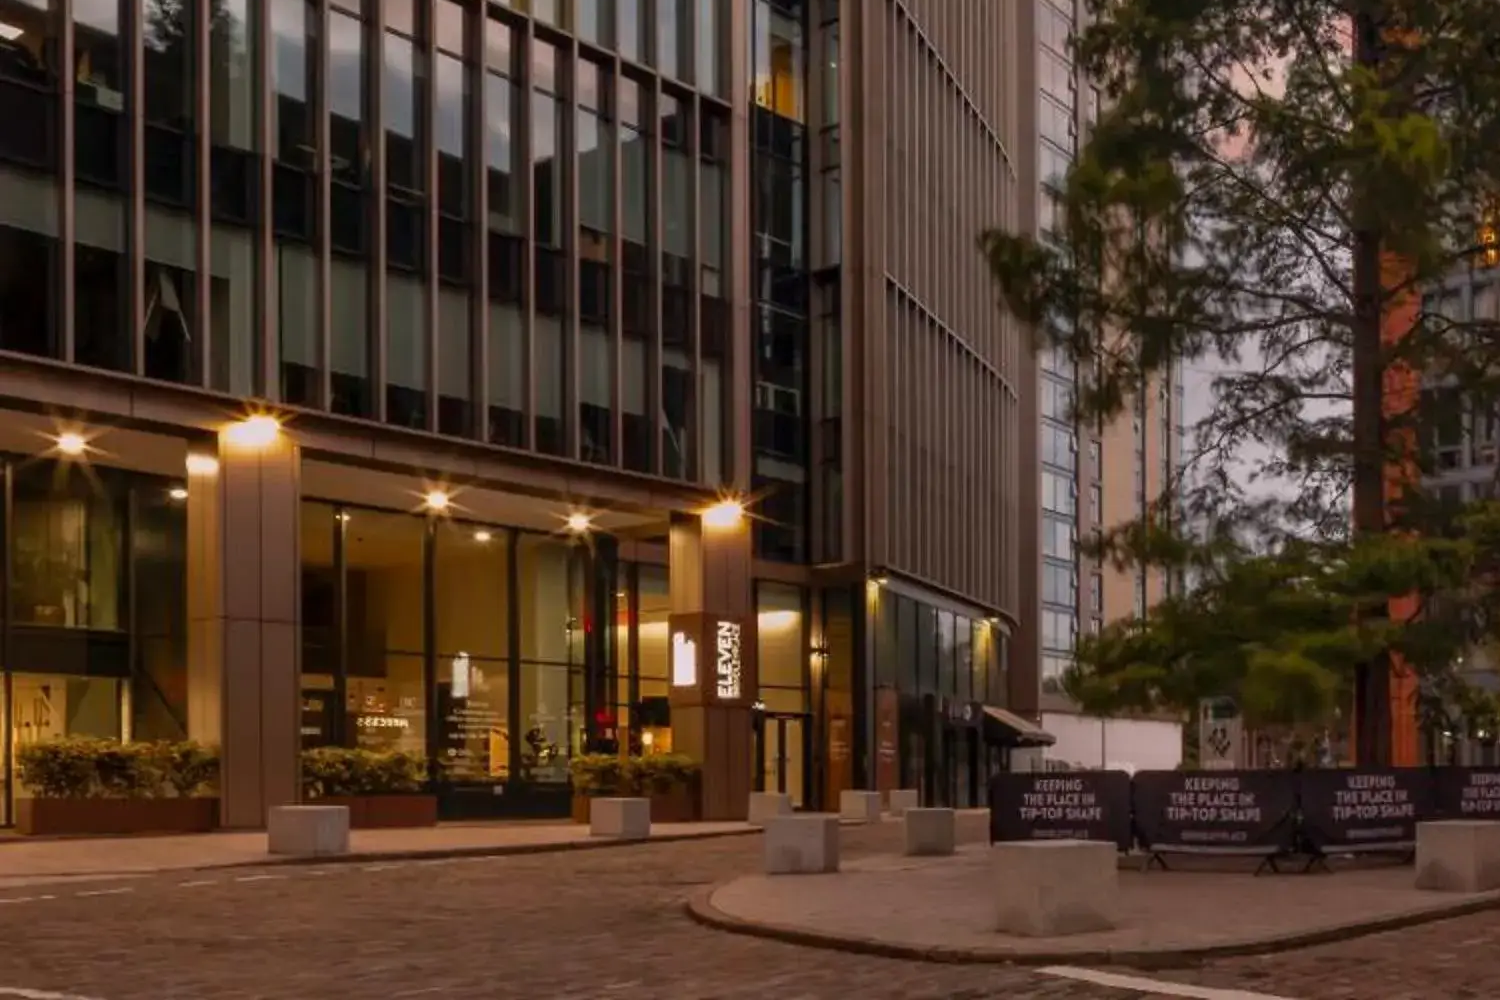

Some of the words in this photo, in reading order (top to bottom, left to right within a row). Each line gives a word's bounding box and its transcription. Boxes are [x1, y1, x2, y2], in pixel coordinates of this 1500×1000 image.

[717, 621, 733, 698] ELEVEN
[1034, 779, 1083, 791] KEEPING
[1185, 778, 1239, 790] KEEPING
[1347, 775, 1395, 788] KEEPING
[1024, 793, 1043, 805] THE
[1046, 793, 1079, 805] PLACE
[1169, 792, 1195, 805] THE
[1197, 793, 1237, 806] PLACE
[1335, 791, 1358, 803] THE
[1361, 791, 1393, 802] PLACE
[1020, 807, 1063, 820] TIP-TOP
[1065, 807, 1102, 820] SHAPE
[1167, 807, 1217, 820] TIP-TOP
[1220, 807, 1261, 821] SHAPE
[1333, 806, 1378, 820] TIP-TOP
[1381, 804, 1414, 817] SHAPE
